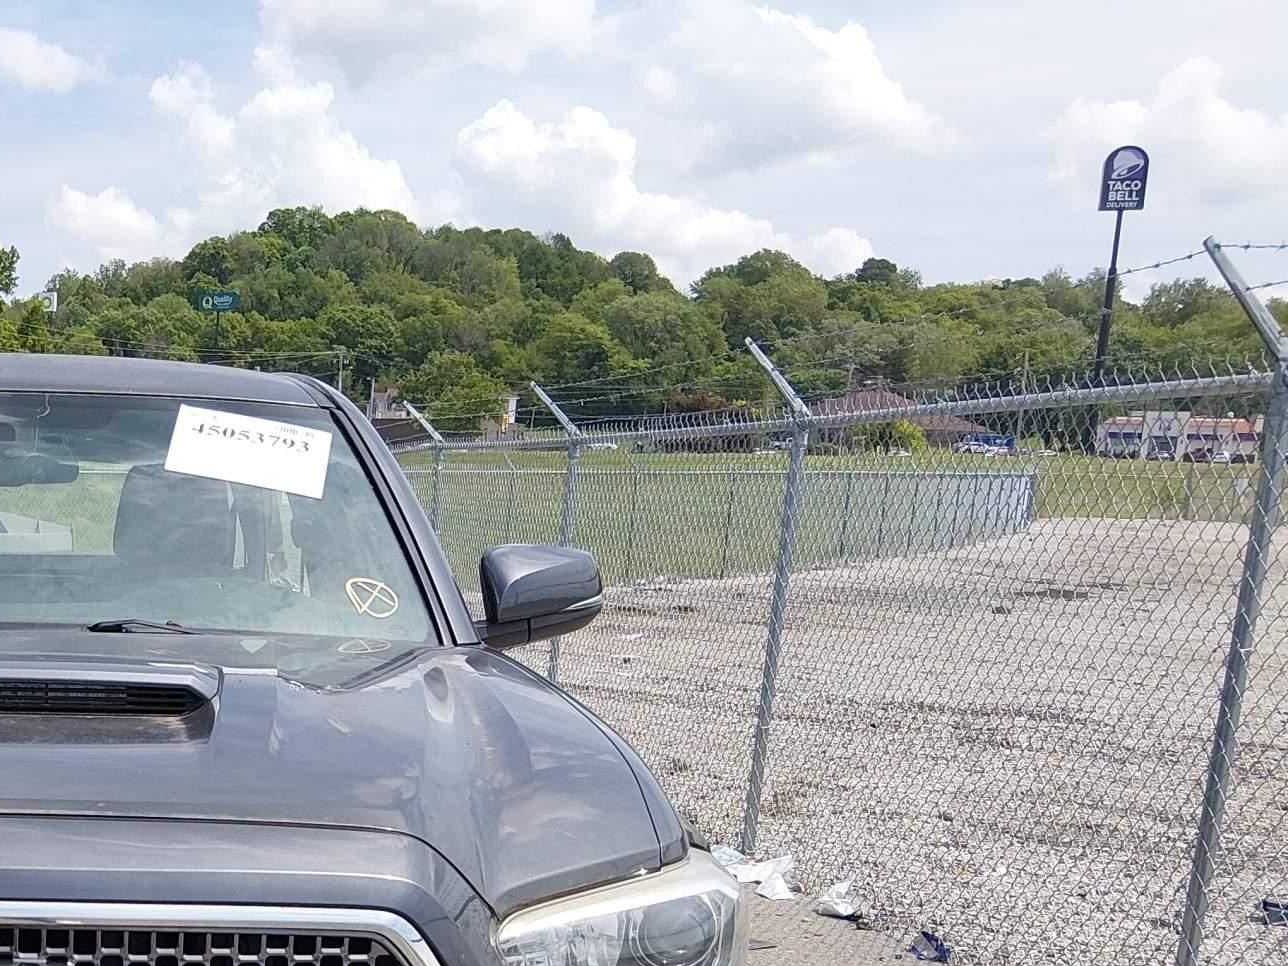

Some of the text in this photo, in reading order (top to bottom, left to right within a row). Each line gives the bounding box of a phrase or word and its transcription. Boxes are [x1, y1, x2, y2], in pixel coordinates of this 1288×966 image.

[1107, 180, 1142, 191] TACO
[1108, 190, 1140, 201] BELL
[191, 423, 310, 452] 45053793
